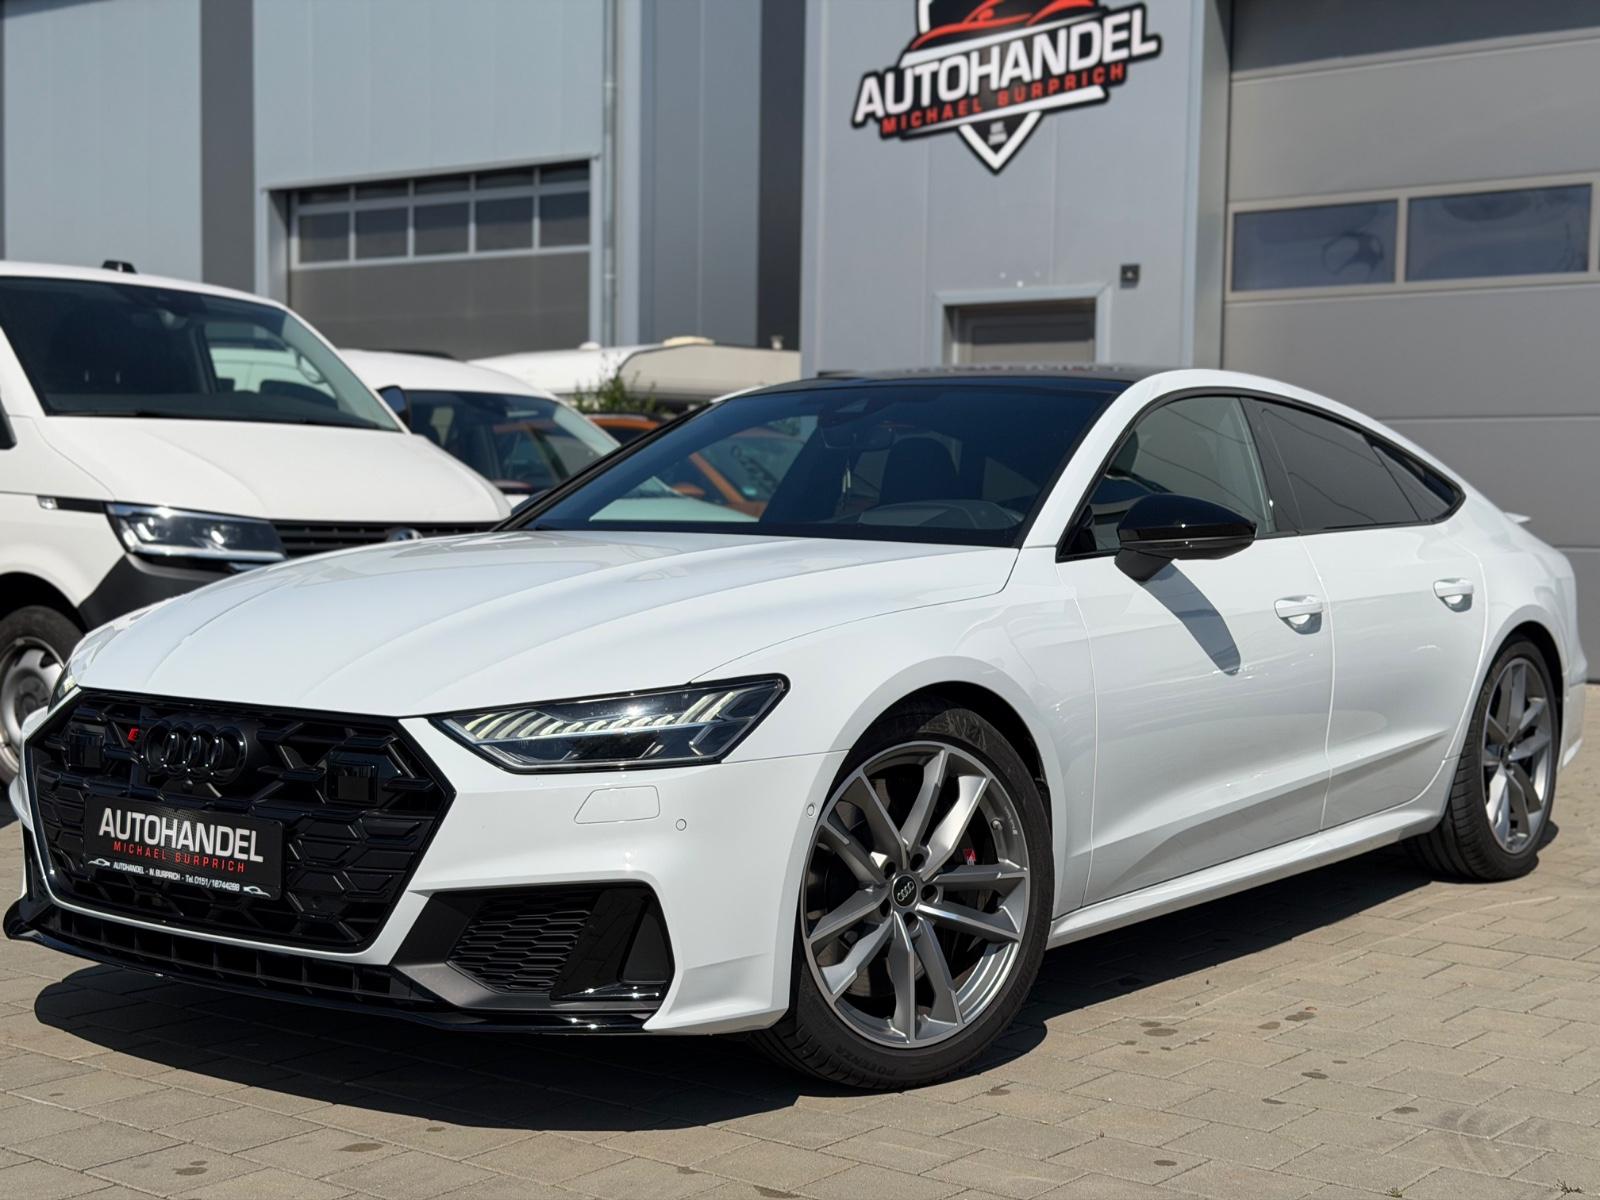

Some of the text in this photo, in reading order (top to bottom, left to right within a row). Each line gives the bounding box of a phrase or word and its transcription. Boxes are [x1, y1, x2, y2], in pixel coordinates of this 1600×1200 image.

[853, 8, 1158, 123] AUTOHANDEL
[882, 63, 1125, 134] MICHAEL BURPRICH
[99, 807, 264, 863] AUTOHANDEL
[113, 841, 245, 873] MICHAEL BURPRICH
[113, 861, 145, 875] AUTOHANDEL
[835, 1045, 897, 1077] POTENZA
